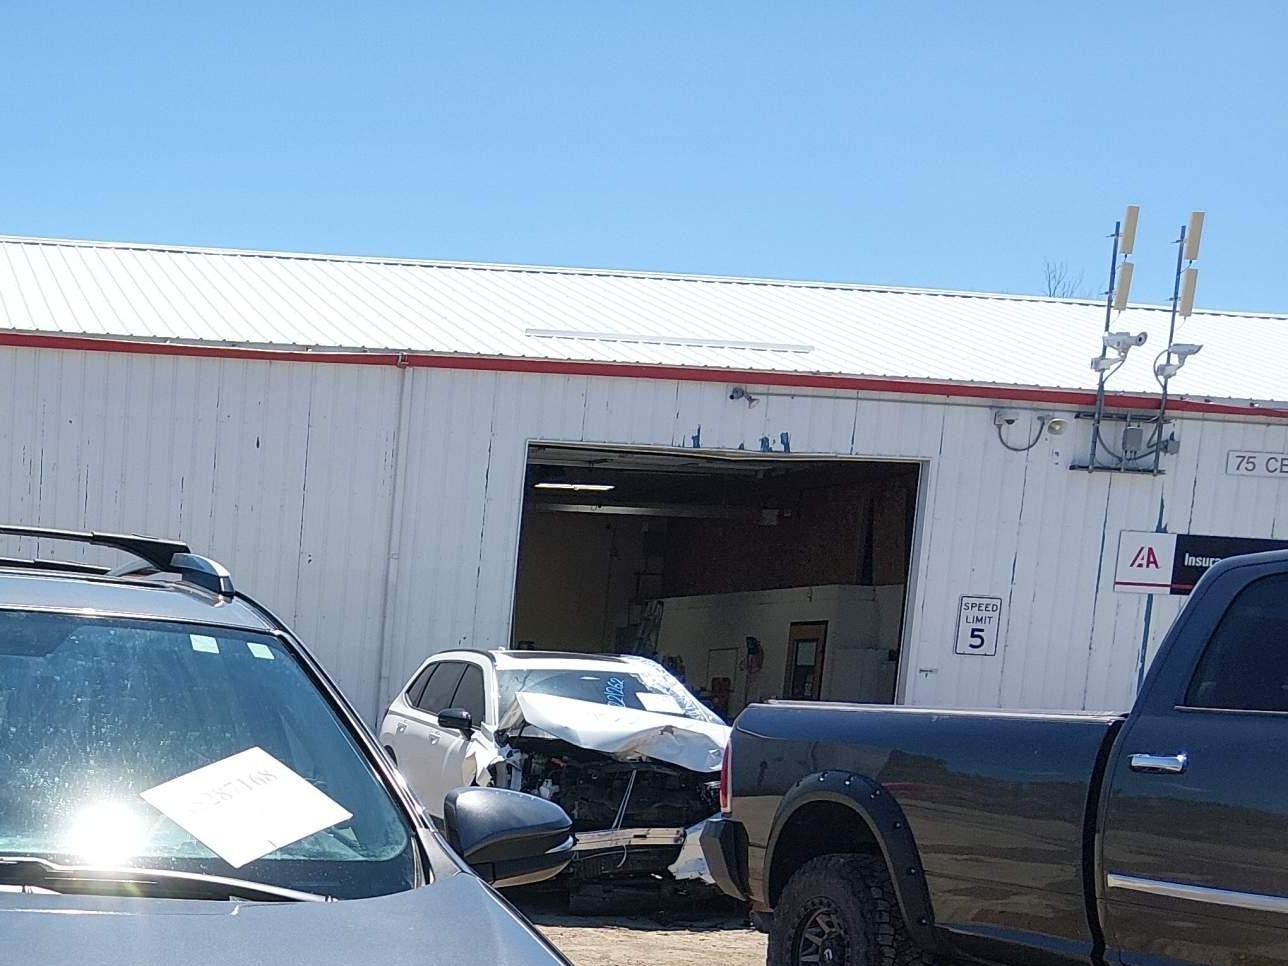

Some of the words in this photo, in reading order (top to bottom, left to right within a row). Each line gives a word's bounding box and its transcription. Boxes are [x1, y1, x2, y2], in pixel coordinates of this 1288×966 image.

[1235, 455, 1257, 472] 75
[963, 602, 999, 612] SPEED
[965, 615, 993, 625] LIMIT
[969, 628, 985, 649] 5
